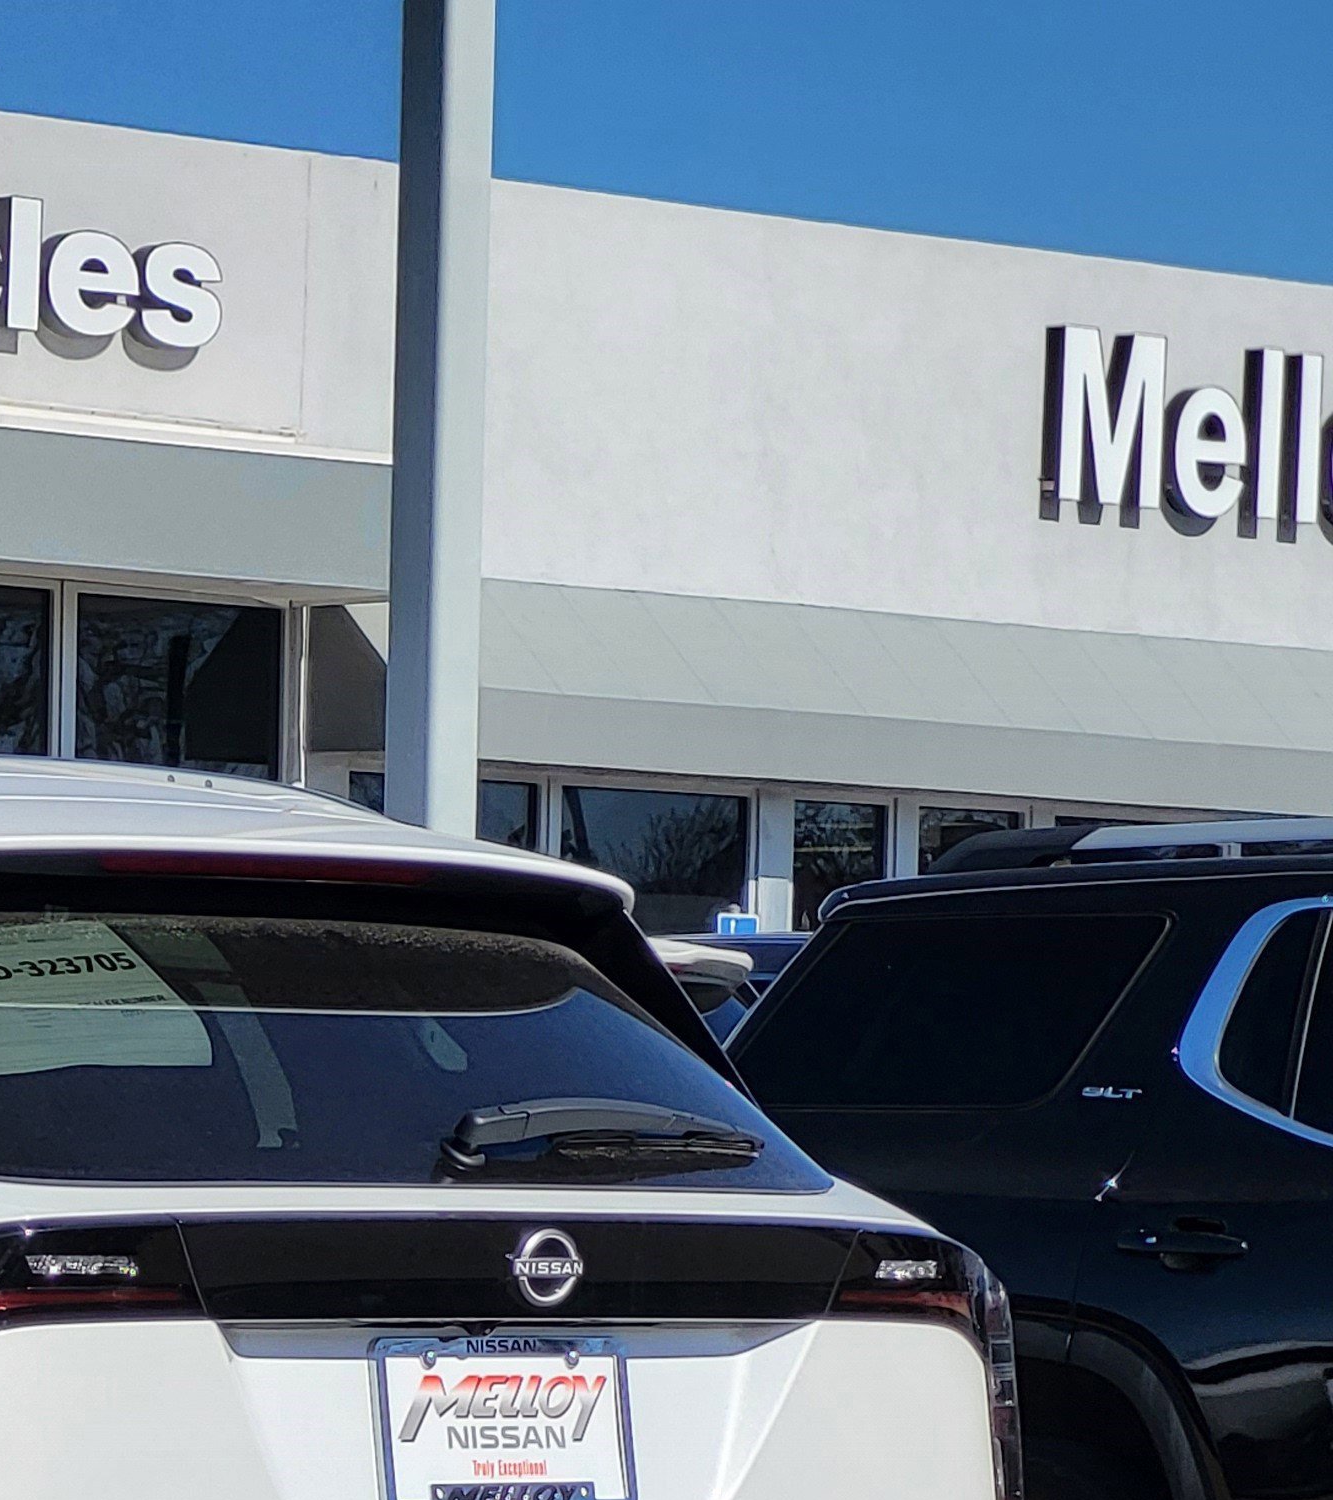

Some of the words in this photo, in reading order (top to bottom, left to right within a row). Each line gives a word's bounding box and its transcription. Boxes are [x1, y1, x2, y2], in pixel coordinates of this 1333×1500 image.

[1041, 321, 1333, 540] Mell
[1081, 1086, 1143, 1100] SLT
[515, 1260, 583, 1275] NISSAN
[466, 1338, 537, 1353] NISSAN
[398, 1374, 607, 1443] MELLOY
[447, 1425, 567, 1450] NISSAN
[473, 1459, 495, 1478] Truly
[498, 1459, 547, 1478] Exceptional
